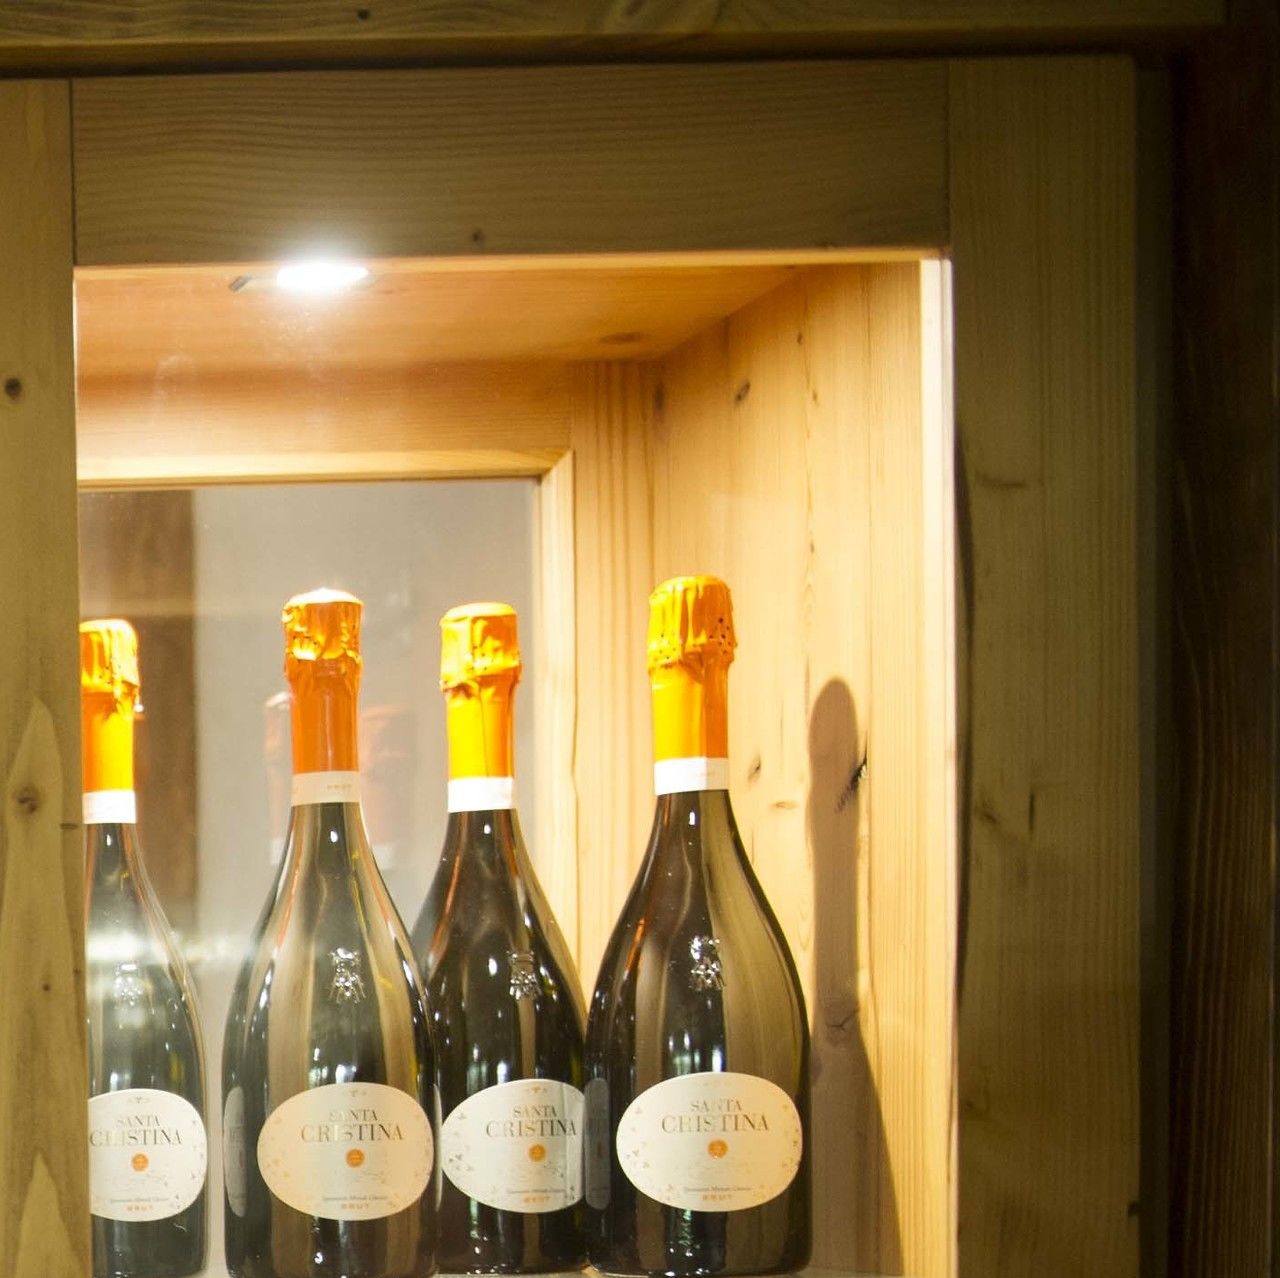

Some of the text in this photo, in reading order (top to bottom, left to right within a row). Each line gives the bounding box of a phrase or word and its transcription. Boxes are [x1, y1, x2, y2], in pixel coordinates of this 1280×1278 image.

[513, 1105, 558, 1118] SANTA
[690, 1098, 742, 1112] SANTA
[329, 1108, 378, 1121] SANTA
[486, 1119, 576, 1137] CRISTINA
[661, 1113, 769, 1133] CRISTINA
[301, 1123, 403, 1142] CRISTINA
